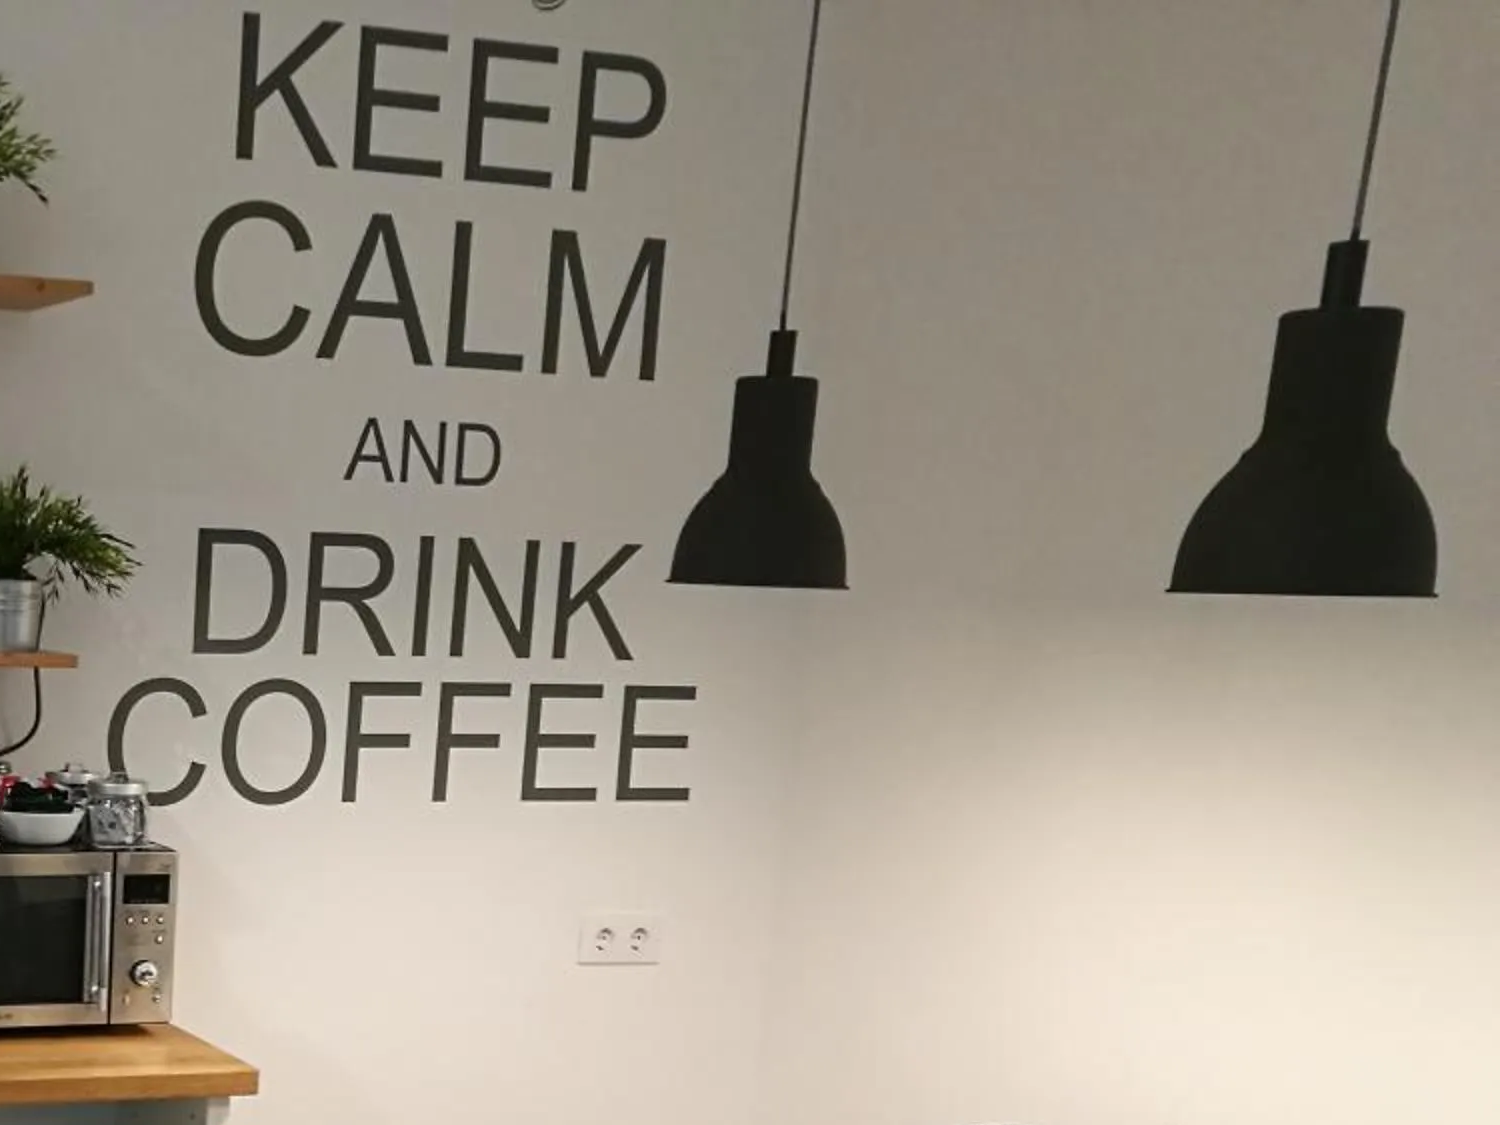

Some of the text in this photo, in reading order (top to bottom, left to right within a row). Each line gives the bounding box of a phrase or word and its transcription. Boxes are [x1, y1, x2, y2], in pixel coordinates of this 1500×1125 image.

[234, 10, 668, 193] KEEP
[193, 199, 668, 382] CALM
[343, 416, 503, 488] AND
[191, 526, 645, 662] DRINK
[105, 676, 698, 807] COFFEE
